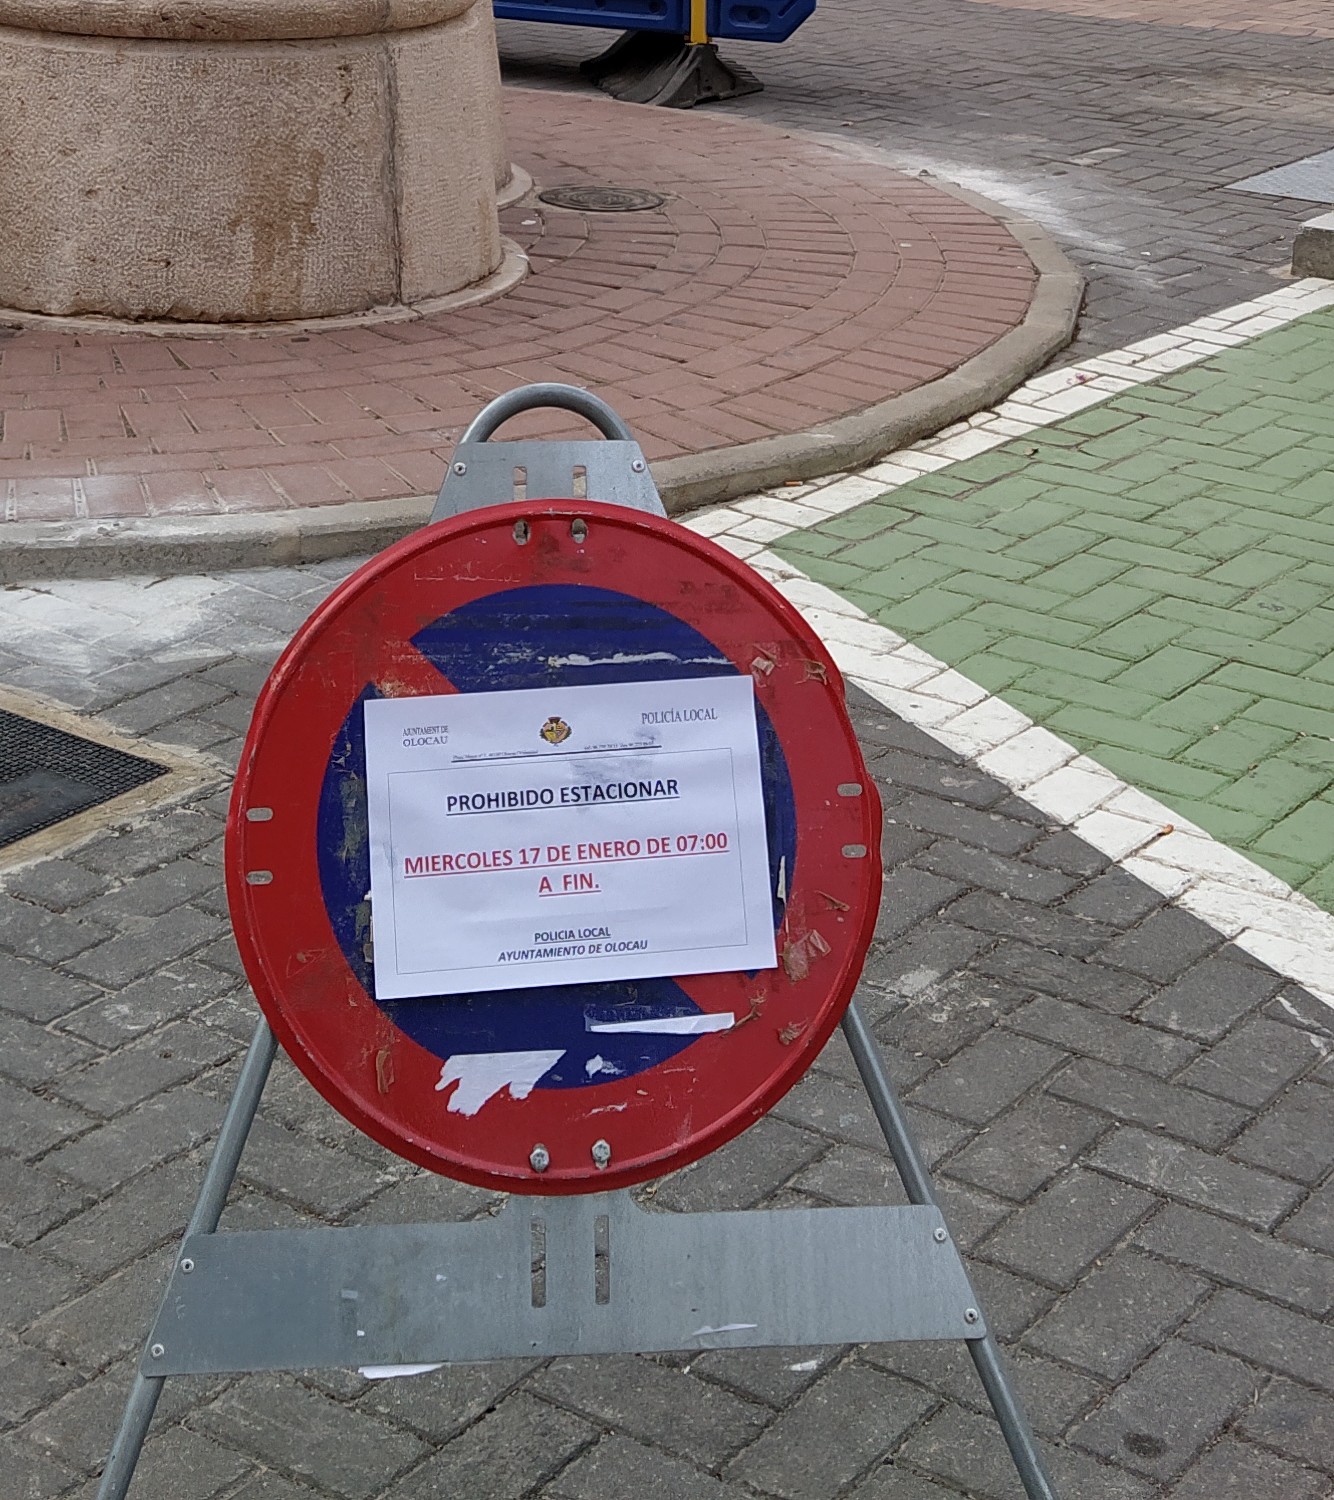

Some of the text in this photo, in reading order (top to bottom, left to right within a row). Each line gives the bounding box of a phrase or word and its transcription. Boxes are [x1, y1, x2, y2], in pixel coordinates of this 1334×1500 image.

[641, 707, 718, 725] POLICÍA LOCAL
[402, 725, 449, 737] AJUNTAMENT DE
[403, 736, 448, 747] OLOCAU
[446, 779, 679, 812] PROHIBIDO ESTACIONAR
[404, 832, 728, 875] MIERCOLES 17 DE ENERO DE 07:00
[538, 872, 599, 893] A FIN.
[534, 927, 611, 943] POLICIA LOCAL
[498, 940, 648, 963] AYUNTAMIENTO DE OLOCAU
